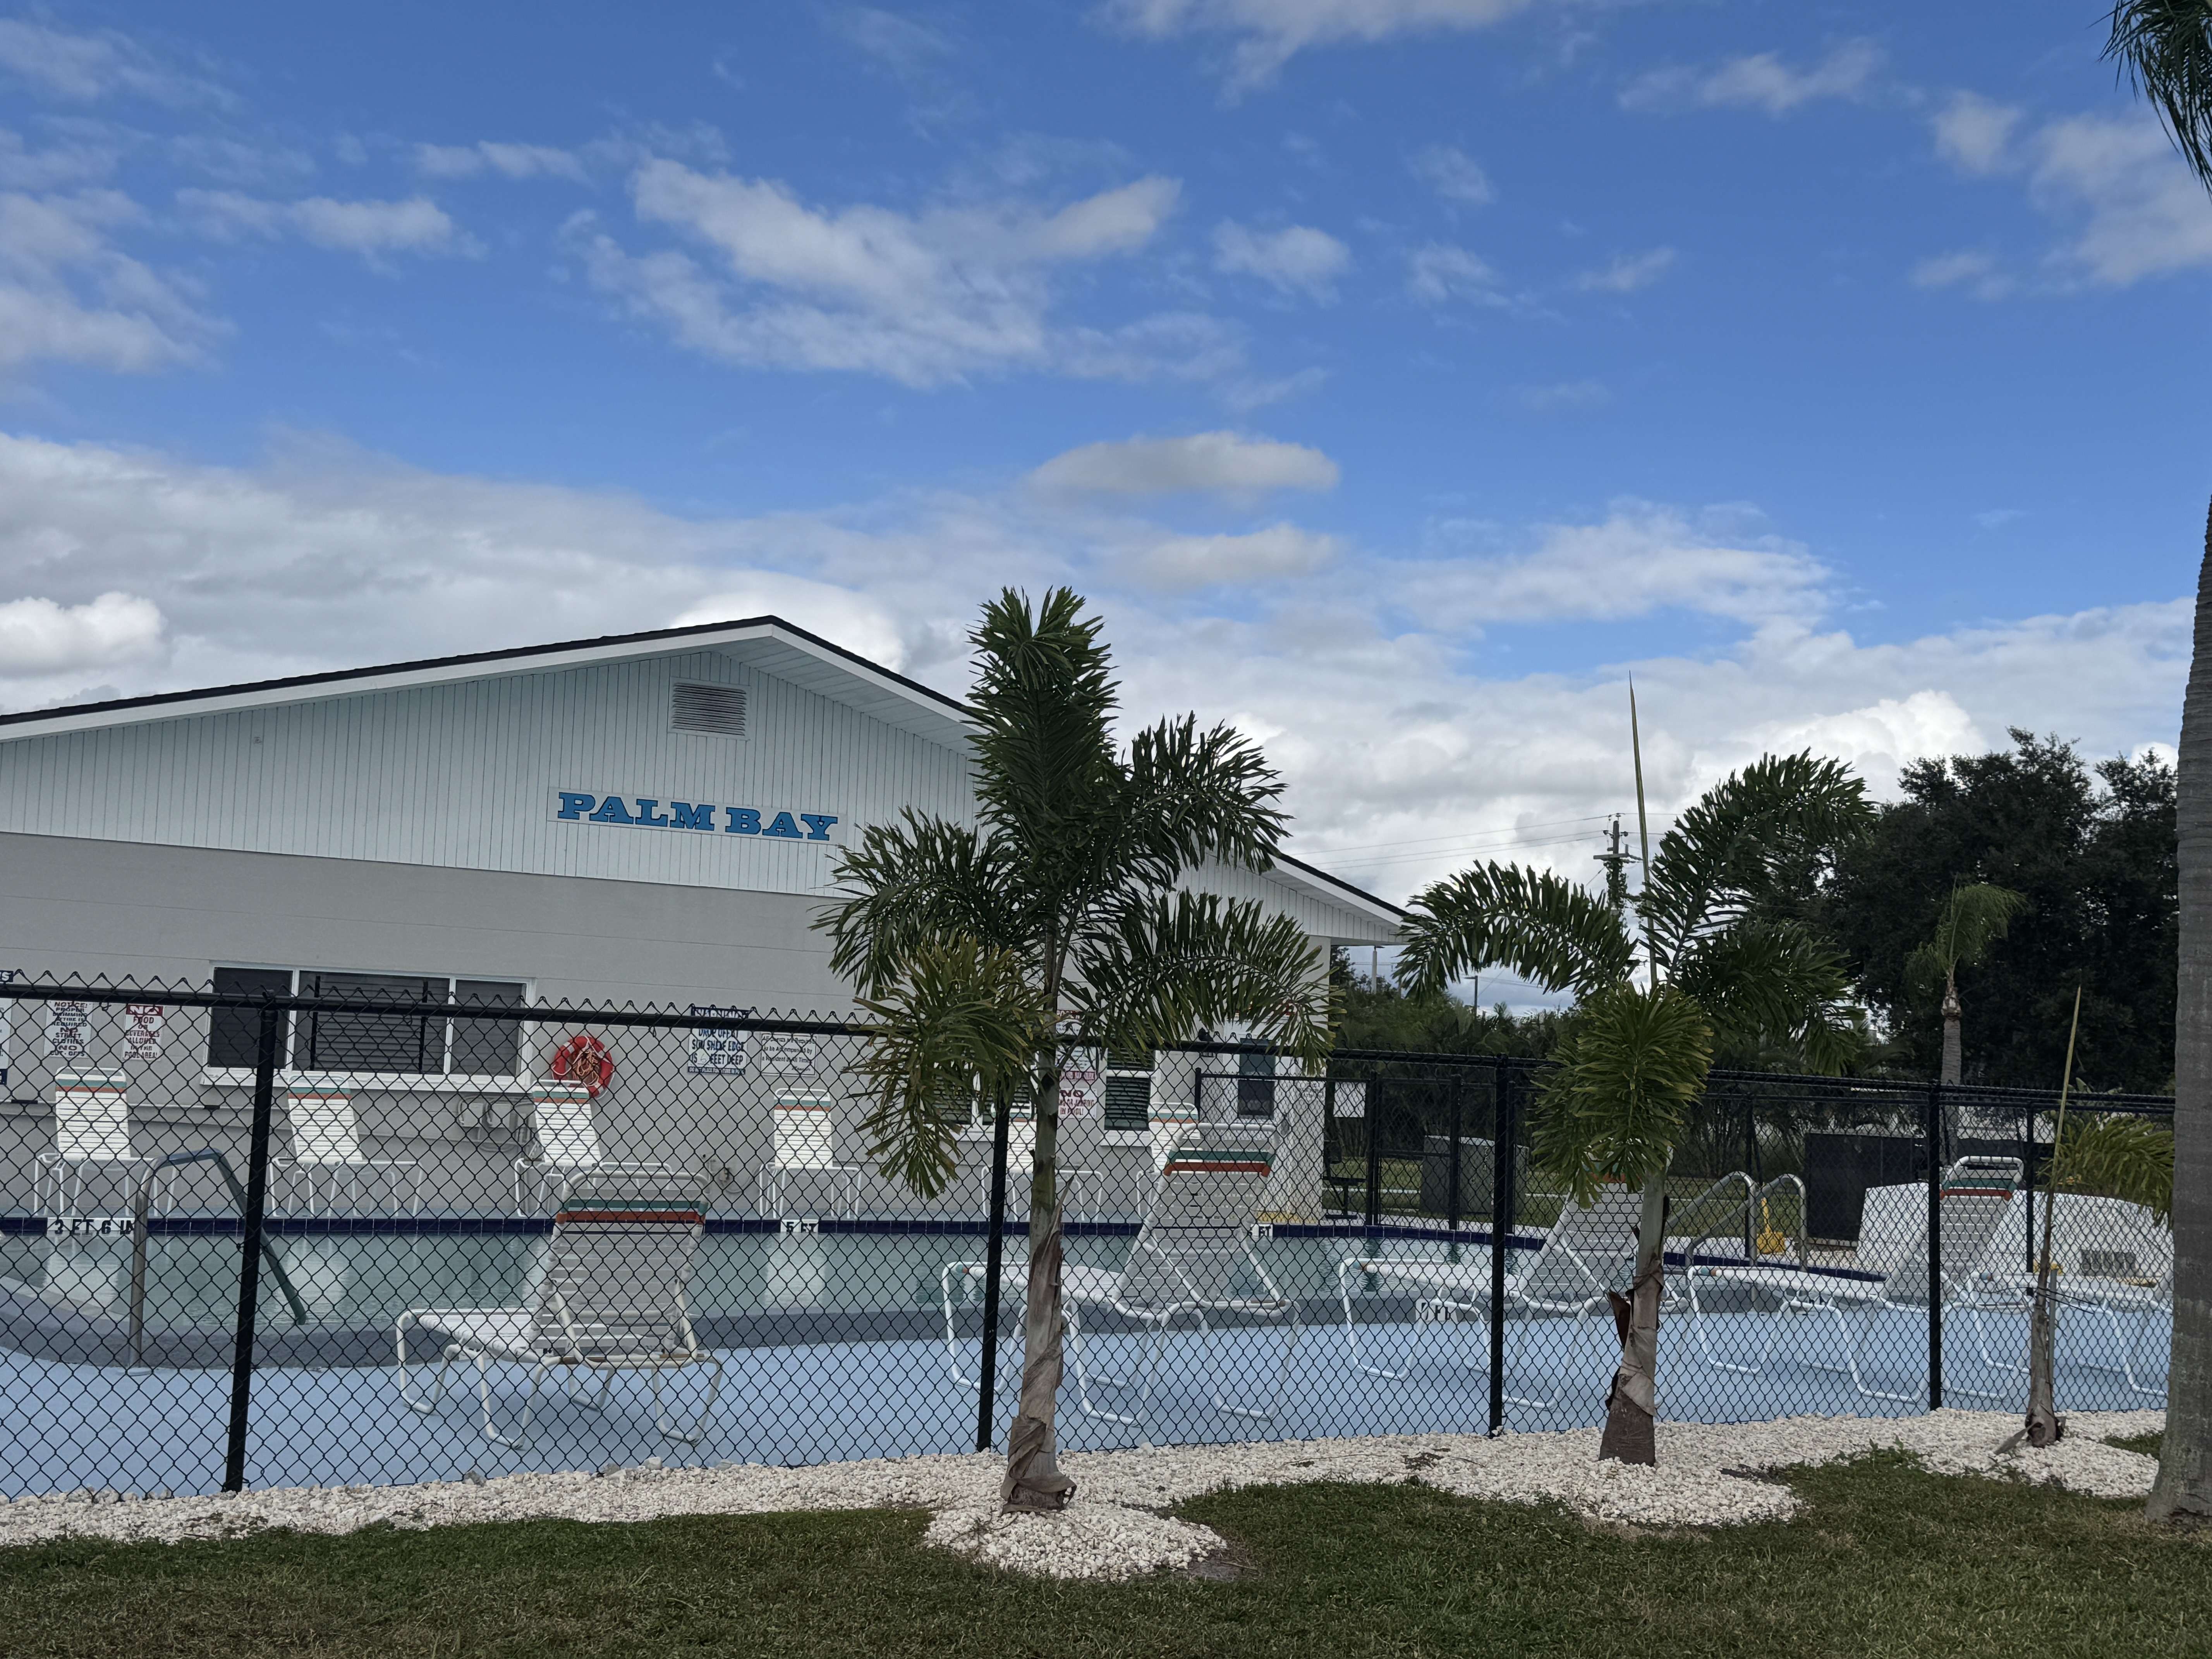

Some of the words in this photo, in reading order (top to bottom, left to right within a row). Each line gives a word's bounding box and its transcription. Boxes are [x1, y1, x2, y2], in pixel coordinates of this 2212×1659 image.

[558, 792, 716, 831] PALM
[725, 807, 838, 841] BAY
[130, 1006, 160, 1015] NO
[55, 1219, 64, 1234] 3
[72, 1219, 94, 1235] FT
[101, 1220, 111, 1234] 6
